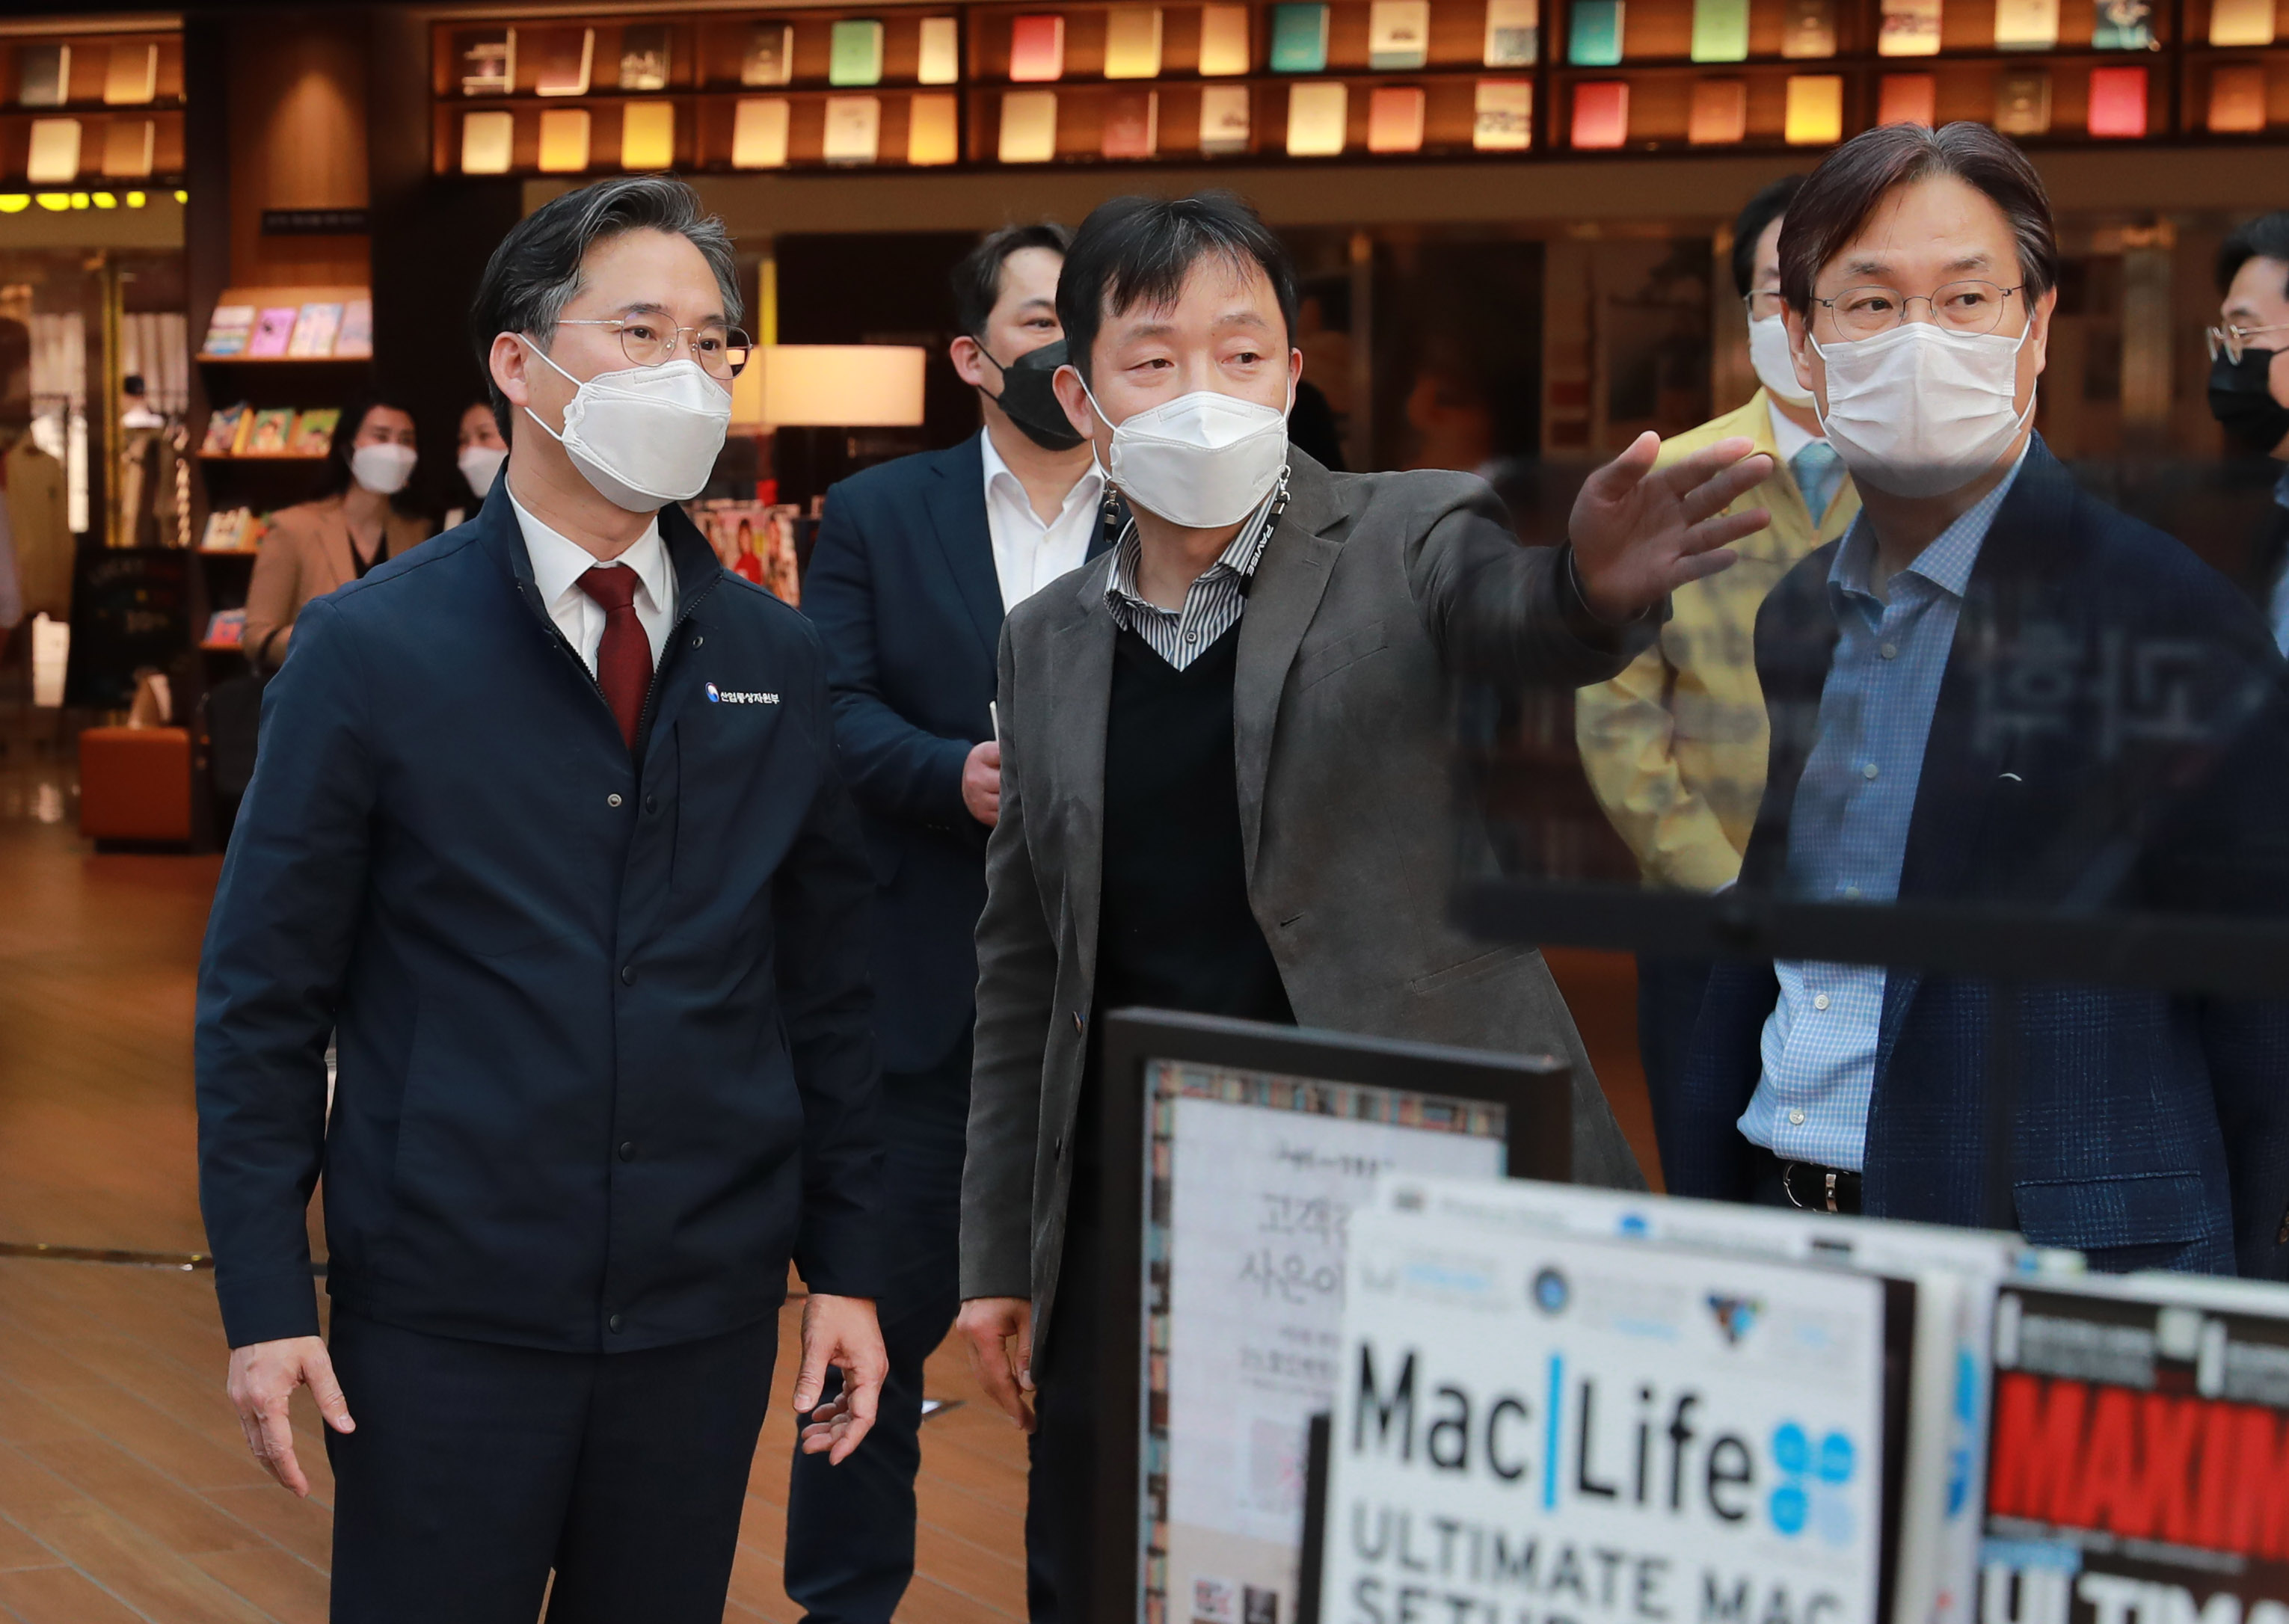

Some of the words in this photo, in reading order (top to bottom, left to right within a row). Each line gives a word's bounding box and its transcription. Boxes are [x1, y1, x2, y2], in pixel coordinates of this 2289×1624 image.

[1247, 524, 1273, 576] PAVISE
[720, 692, 780, 704] 산업통상자원부
[1352, 1501, 1671, 1620] ULTIMATE
